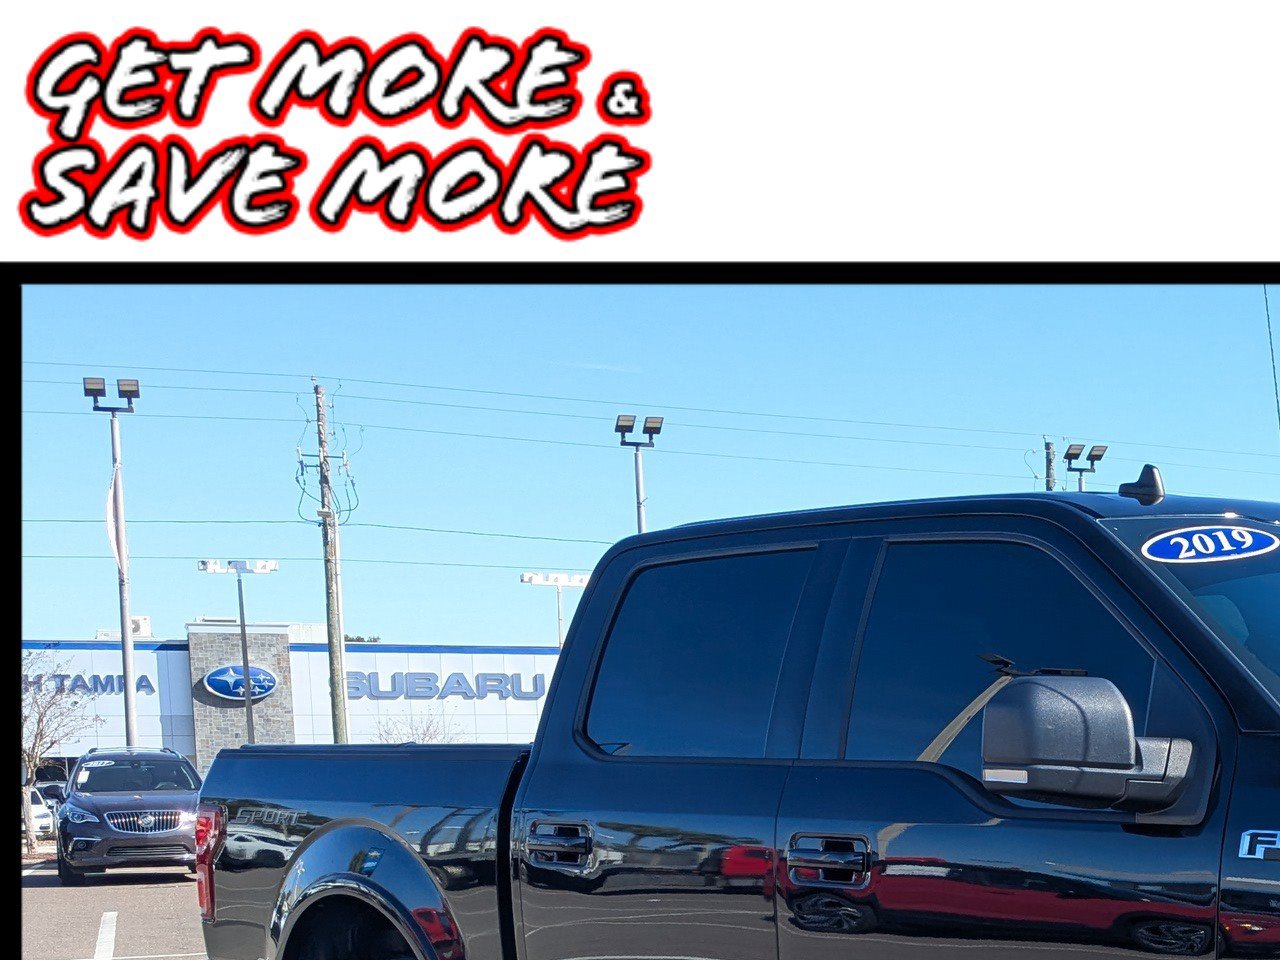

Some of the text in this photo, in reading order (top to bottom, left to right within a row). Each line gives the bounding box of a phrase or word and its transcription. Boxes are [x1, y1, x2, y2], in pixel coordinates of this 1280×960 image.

[1169, 528, 1254, 559] 2019
[345, 671, 546, 700] SUBARU
[237, 806, 308, 825] SPORT
